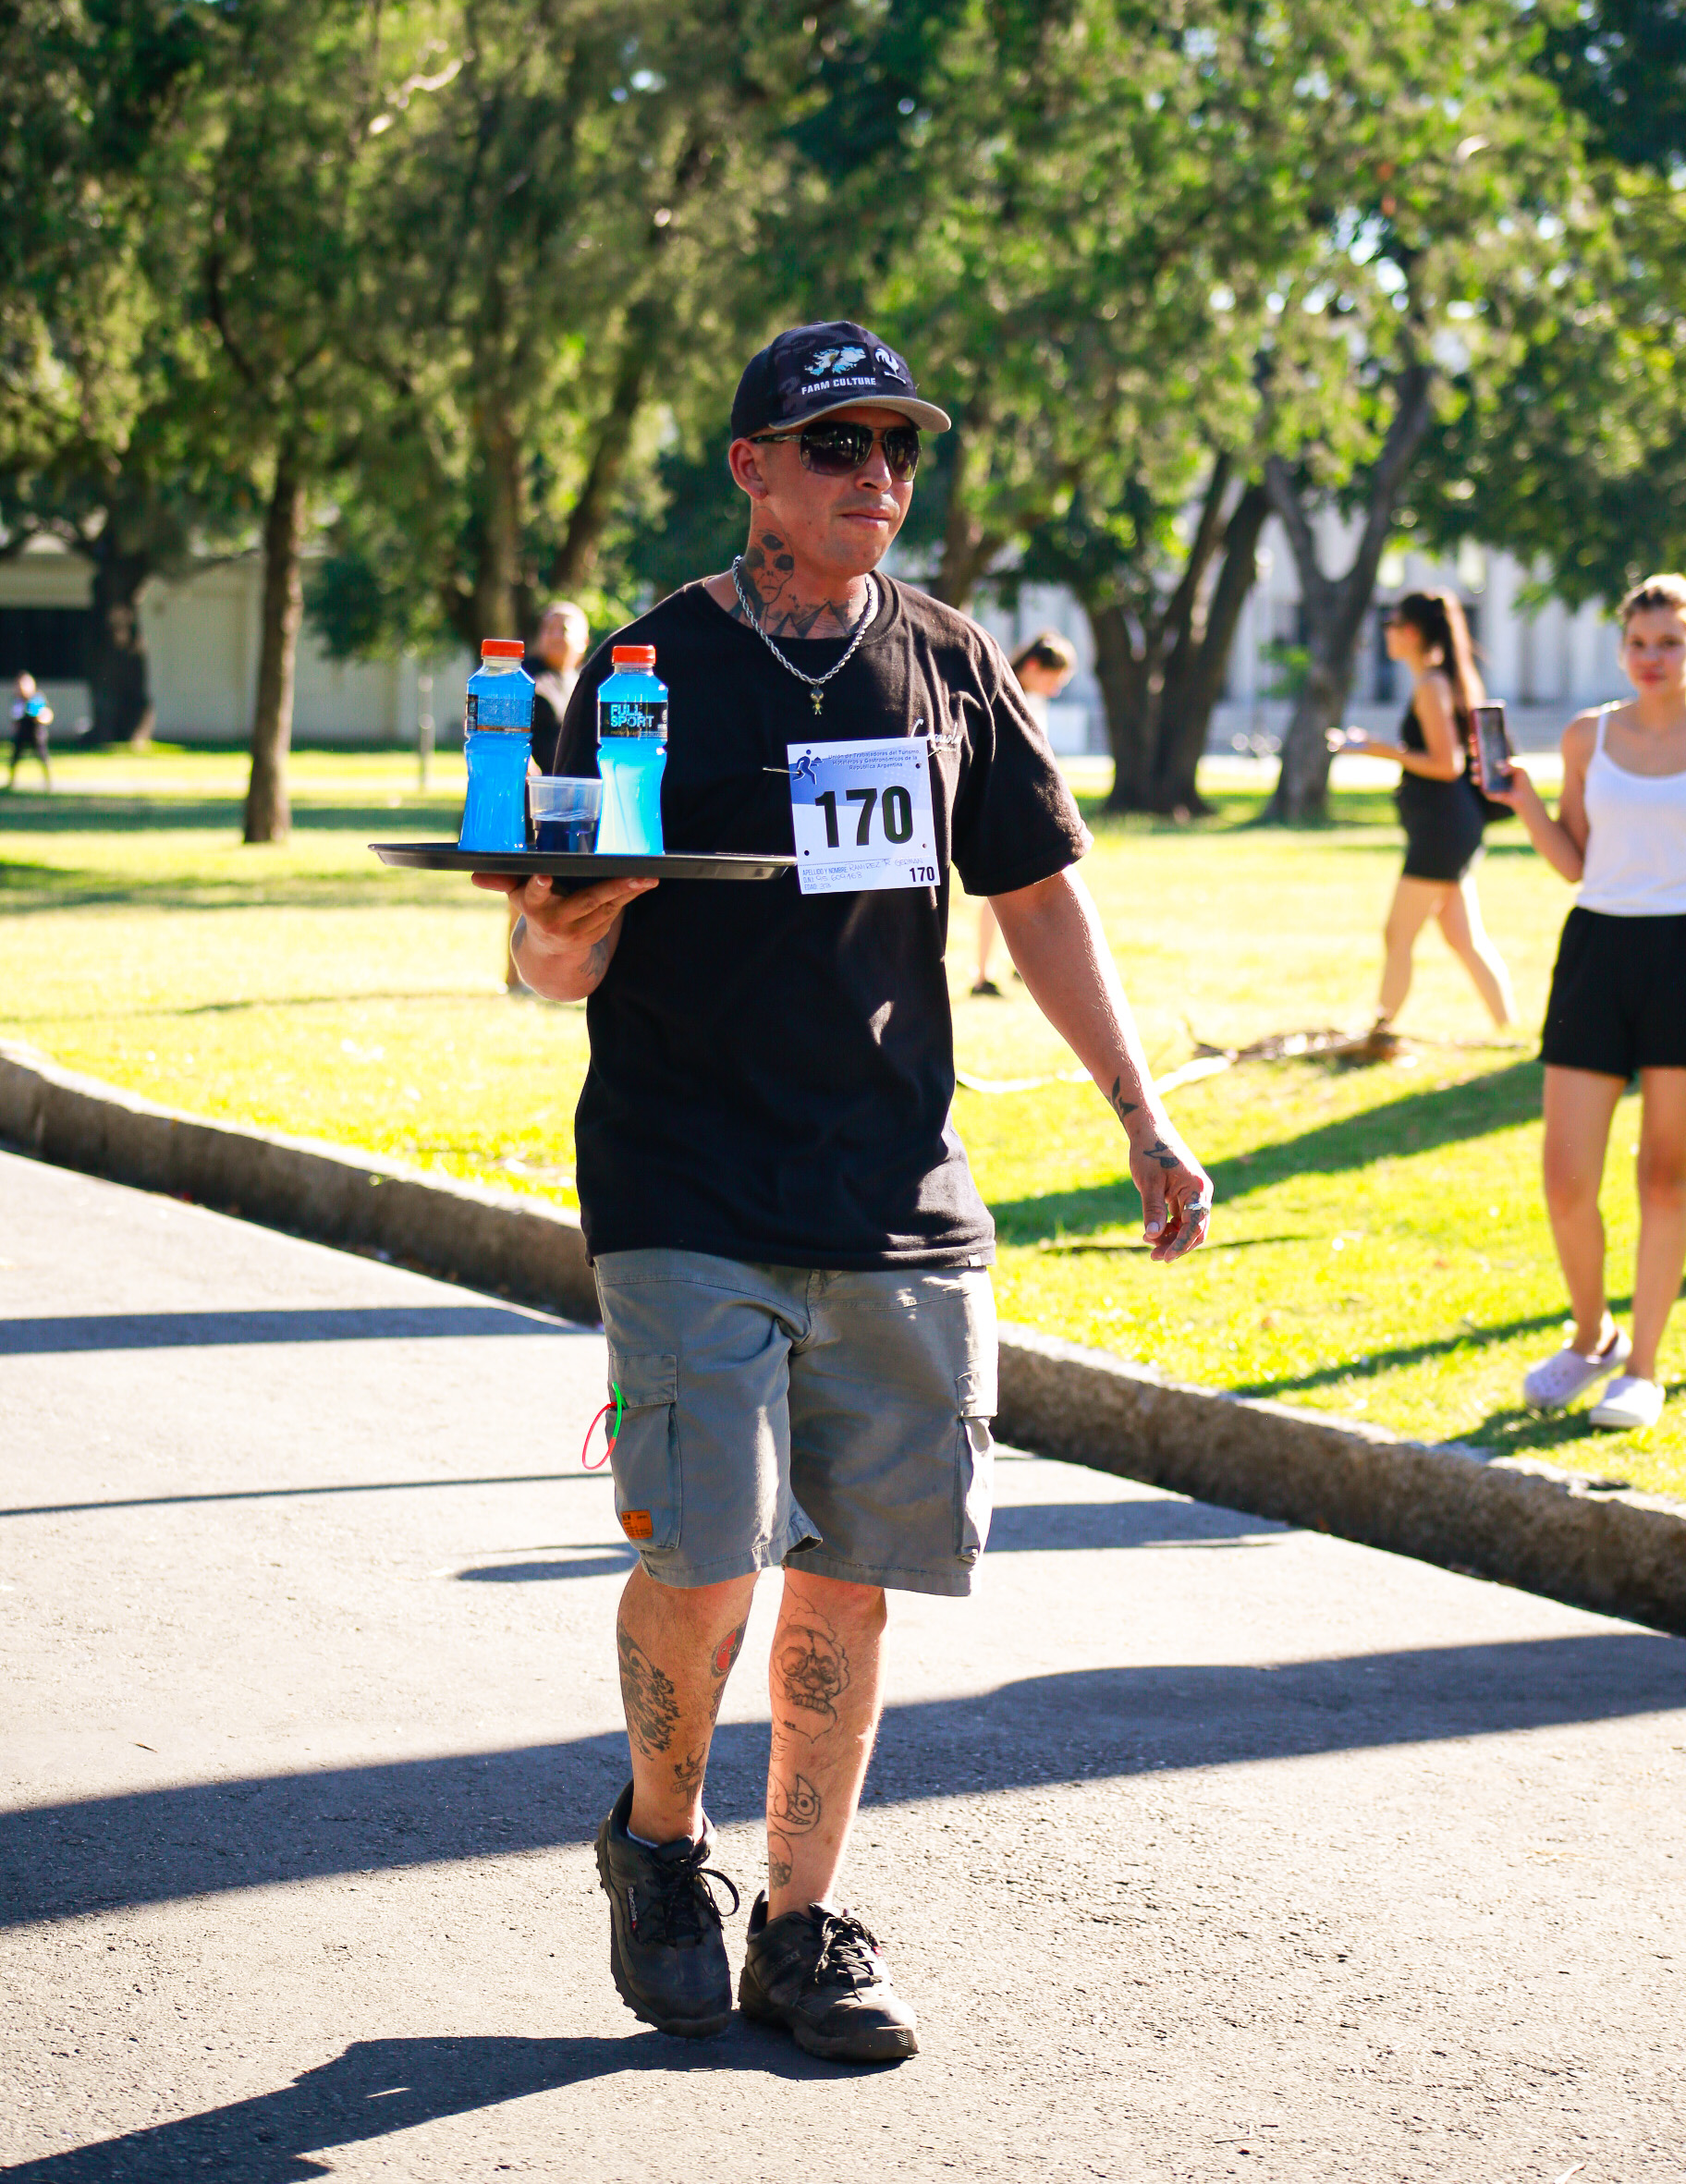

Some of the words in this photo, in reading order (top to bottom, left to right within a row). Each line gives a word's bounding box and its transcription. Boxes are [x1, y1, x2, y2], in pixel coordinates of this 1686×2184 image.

[800, 381, 830, 396] FARM
[833, 376, 876, 387] CULTURE
[610, 704, 643, 716] FULL
[610, 715, 654, 727] SPORT
[814, 786, 913, 848] 170
[909, 866, 935, 883] 170
